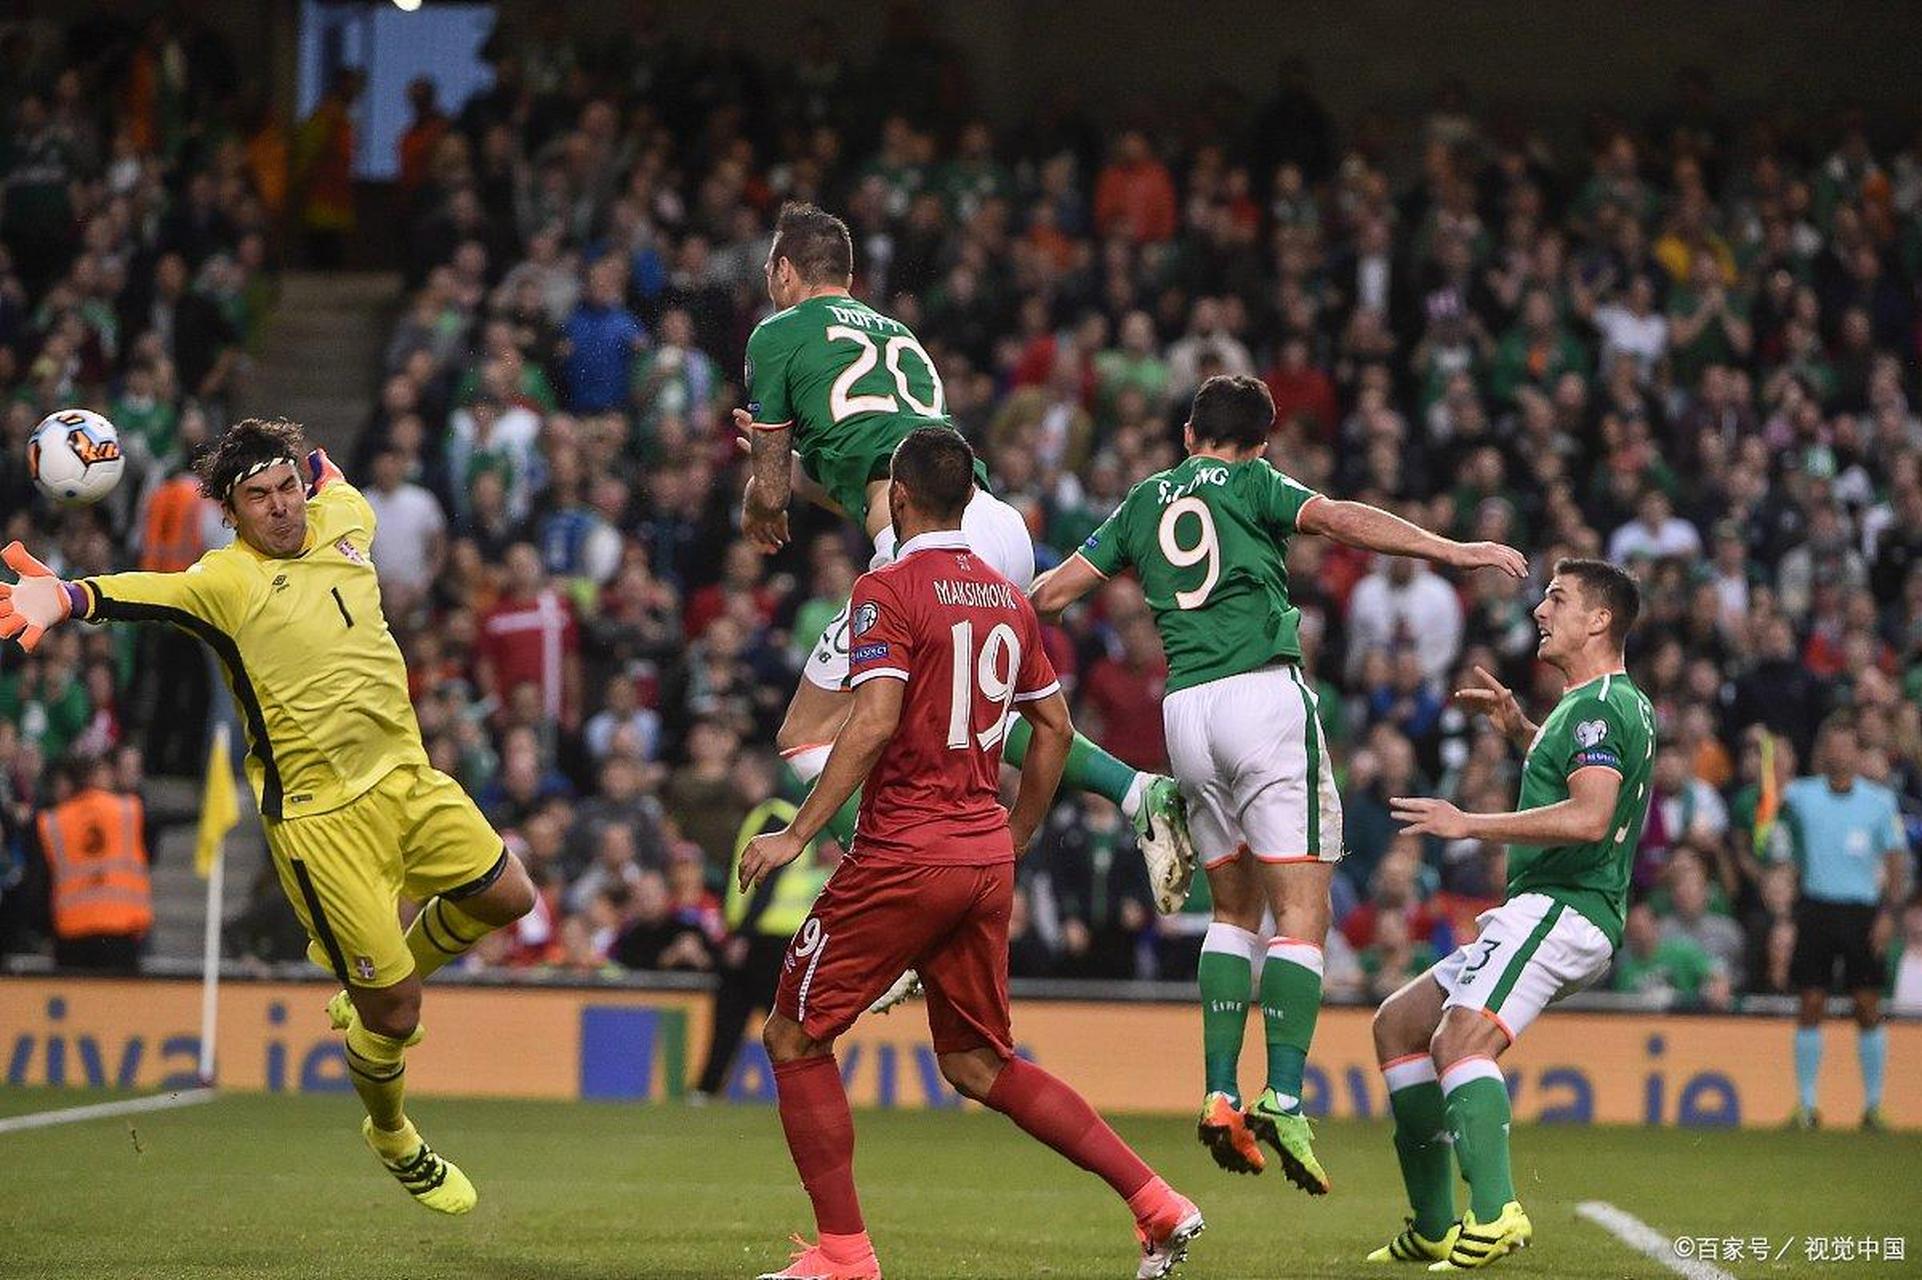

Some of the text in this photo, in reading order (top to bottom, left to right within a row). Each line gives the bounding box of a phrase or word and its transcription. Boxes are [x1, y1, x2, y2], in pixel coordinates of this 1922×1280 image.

[826, 325, 944, 423] 20
[1158, 496, 1220, 610] 9
[331, 587, 354, 628] 1
[946, 619, 1022, 753] 19
[1465, 939, 1502, 972] 3
[1645, 1032, 1740, 1127] ie
